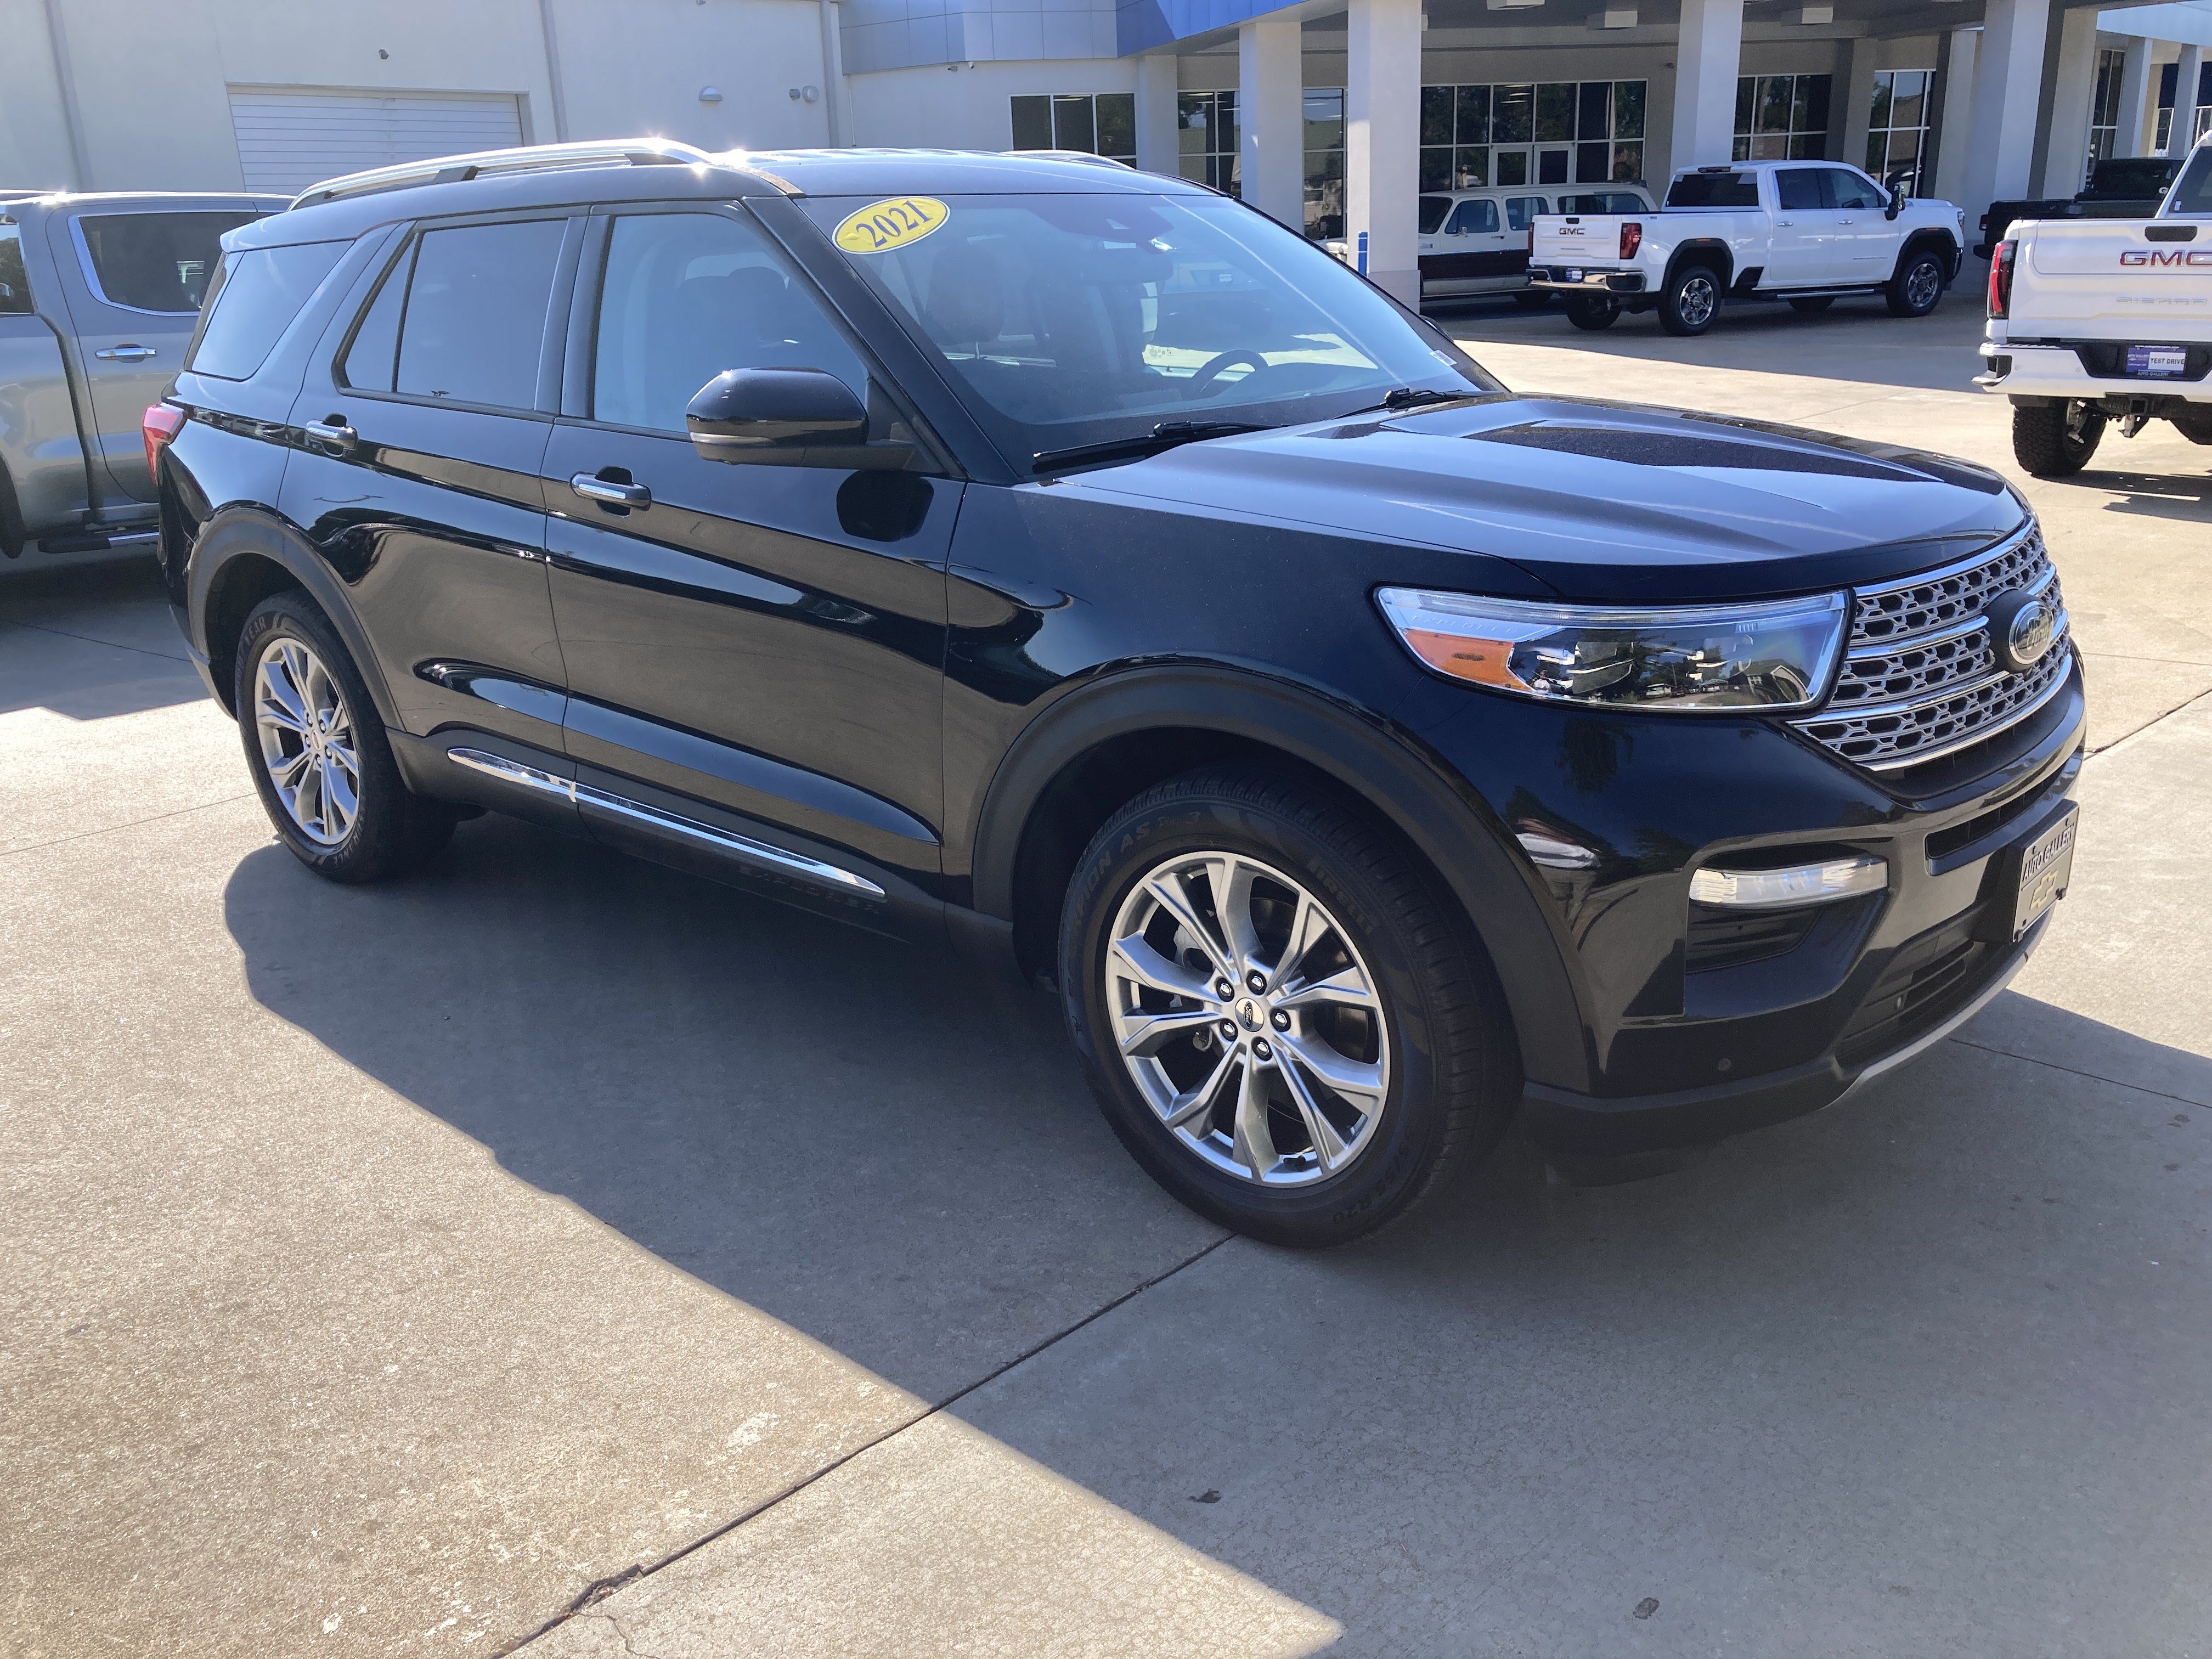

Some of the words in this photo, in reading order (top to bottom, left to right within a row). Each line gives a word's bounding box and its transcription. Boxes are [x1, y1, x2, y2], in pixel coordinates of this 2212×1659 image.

[856, 200, 933, 248] 2021
[2120, 250, 2212, 268] GMC
[2116, 297, 2208, 305] SIERRA
[1120, 821, 1152, 852] AS
[2022, 851, 2043, 882] AUTO
[2043, 822, 2075, 864] GALLERY
[1306, 855, 1381, 935] PIRELLI
